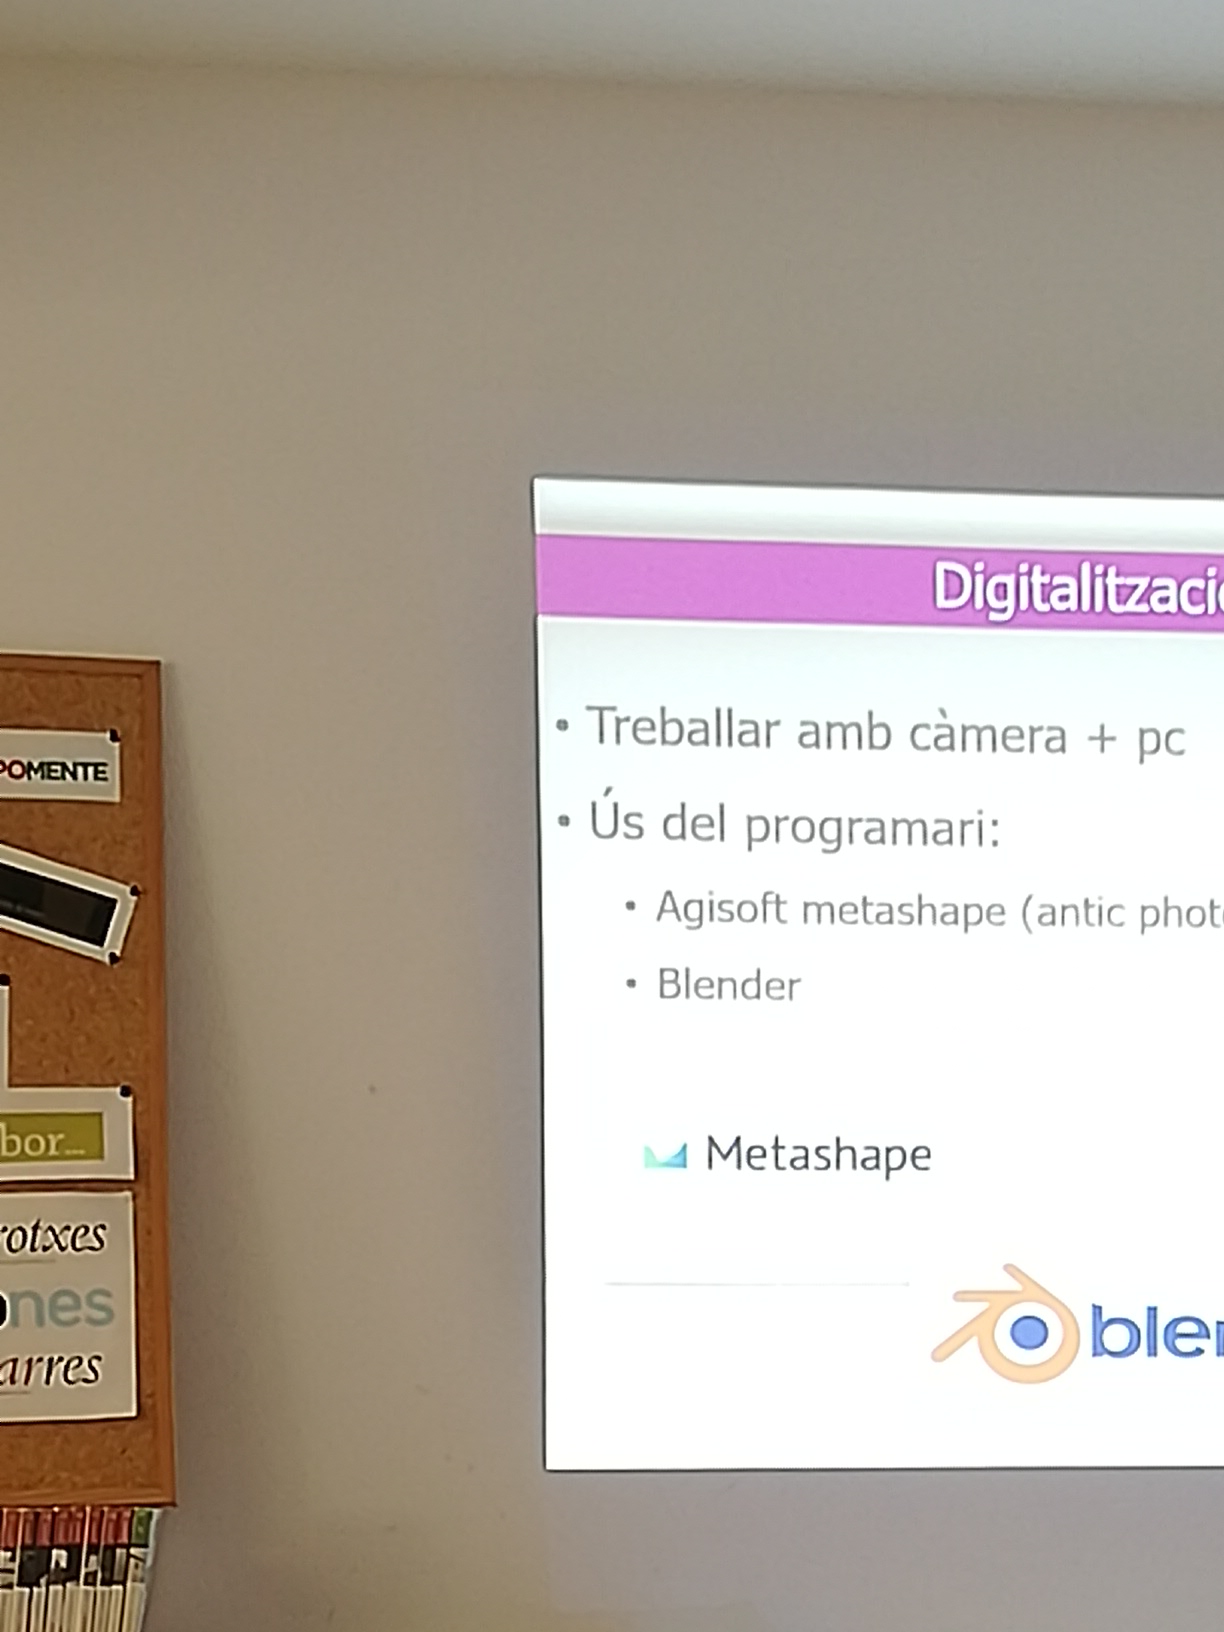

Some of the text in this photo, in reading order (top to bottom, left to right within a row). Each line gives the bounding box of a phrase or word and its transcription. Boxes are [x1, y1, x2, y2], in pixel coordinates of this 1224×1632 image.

[585, 705, 1185, 765] Treballar amb càmera + pc
[590, 786, 999, 855] Ús del programari:
[656, 889, 788, 931] Agisoft
[803, 893, 1006, 934] metashape
[1021, 894, 1125, 935] (antic
[659, 966, 802, 1002] Blender
[707, 1135, 932, 1182] Metashape
